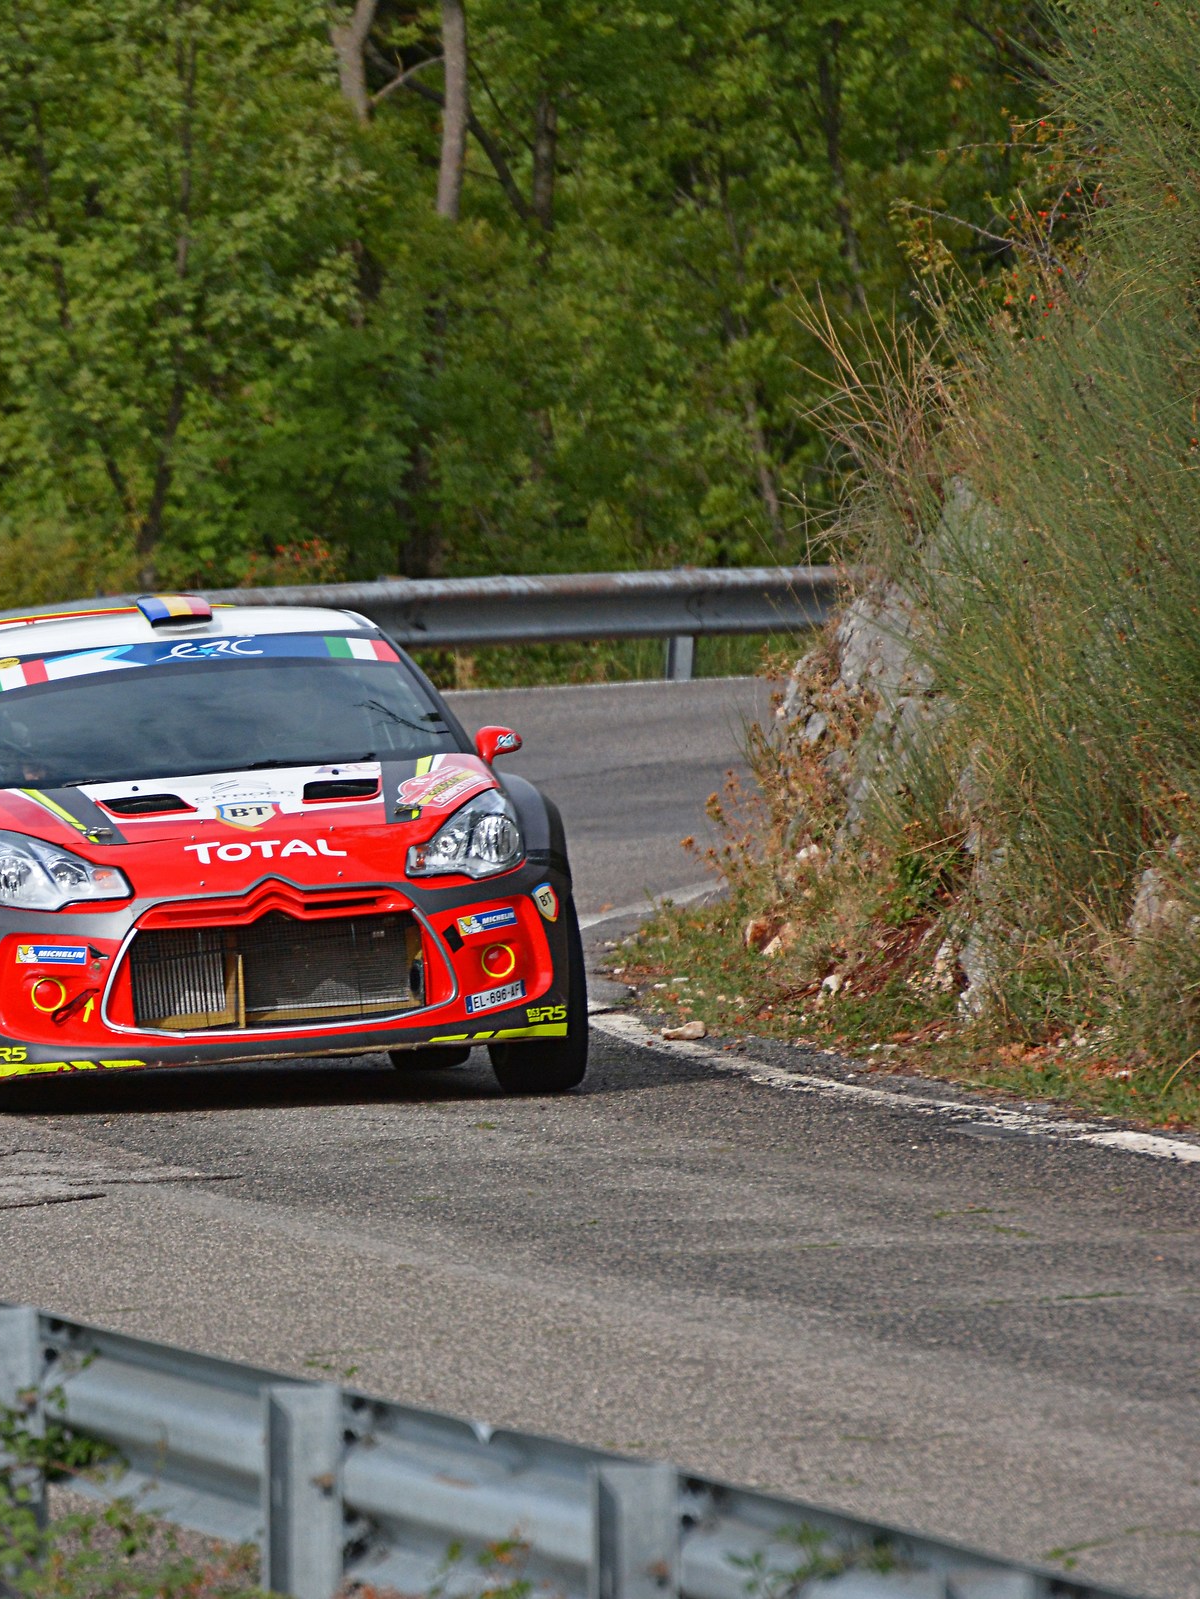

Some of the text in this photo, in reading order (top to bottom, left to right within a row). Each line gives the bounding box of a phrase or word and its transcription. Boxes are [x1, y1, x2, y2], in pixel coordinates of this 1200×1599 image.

[228, 806, 269, 817] BT
[184, 839, 347, 865] TOTAL
[538, 891, 554, 907] BT
[482, 911, 515, 925] MICHELIN
[37, 950, 85, 959] MICHELIN
[473, 983, 521, 1009] EL-696-AF
[540, 1005, 567, 1021] R5
